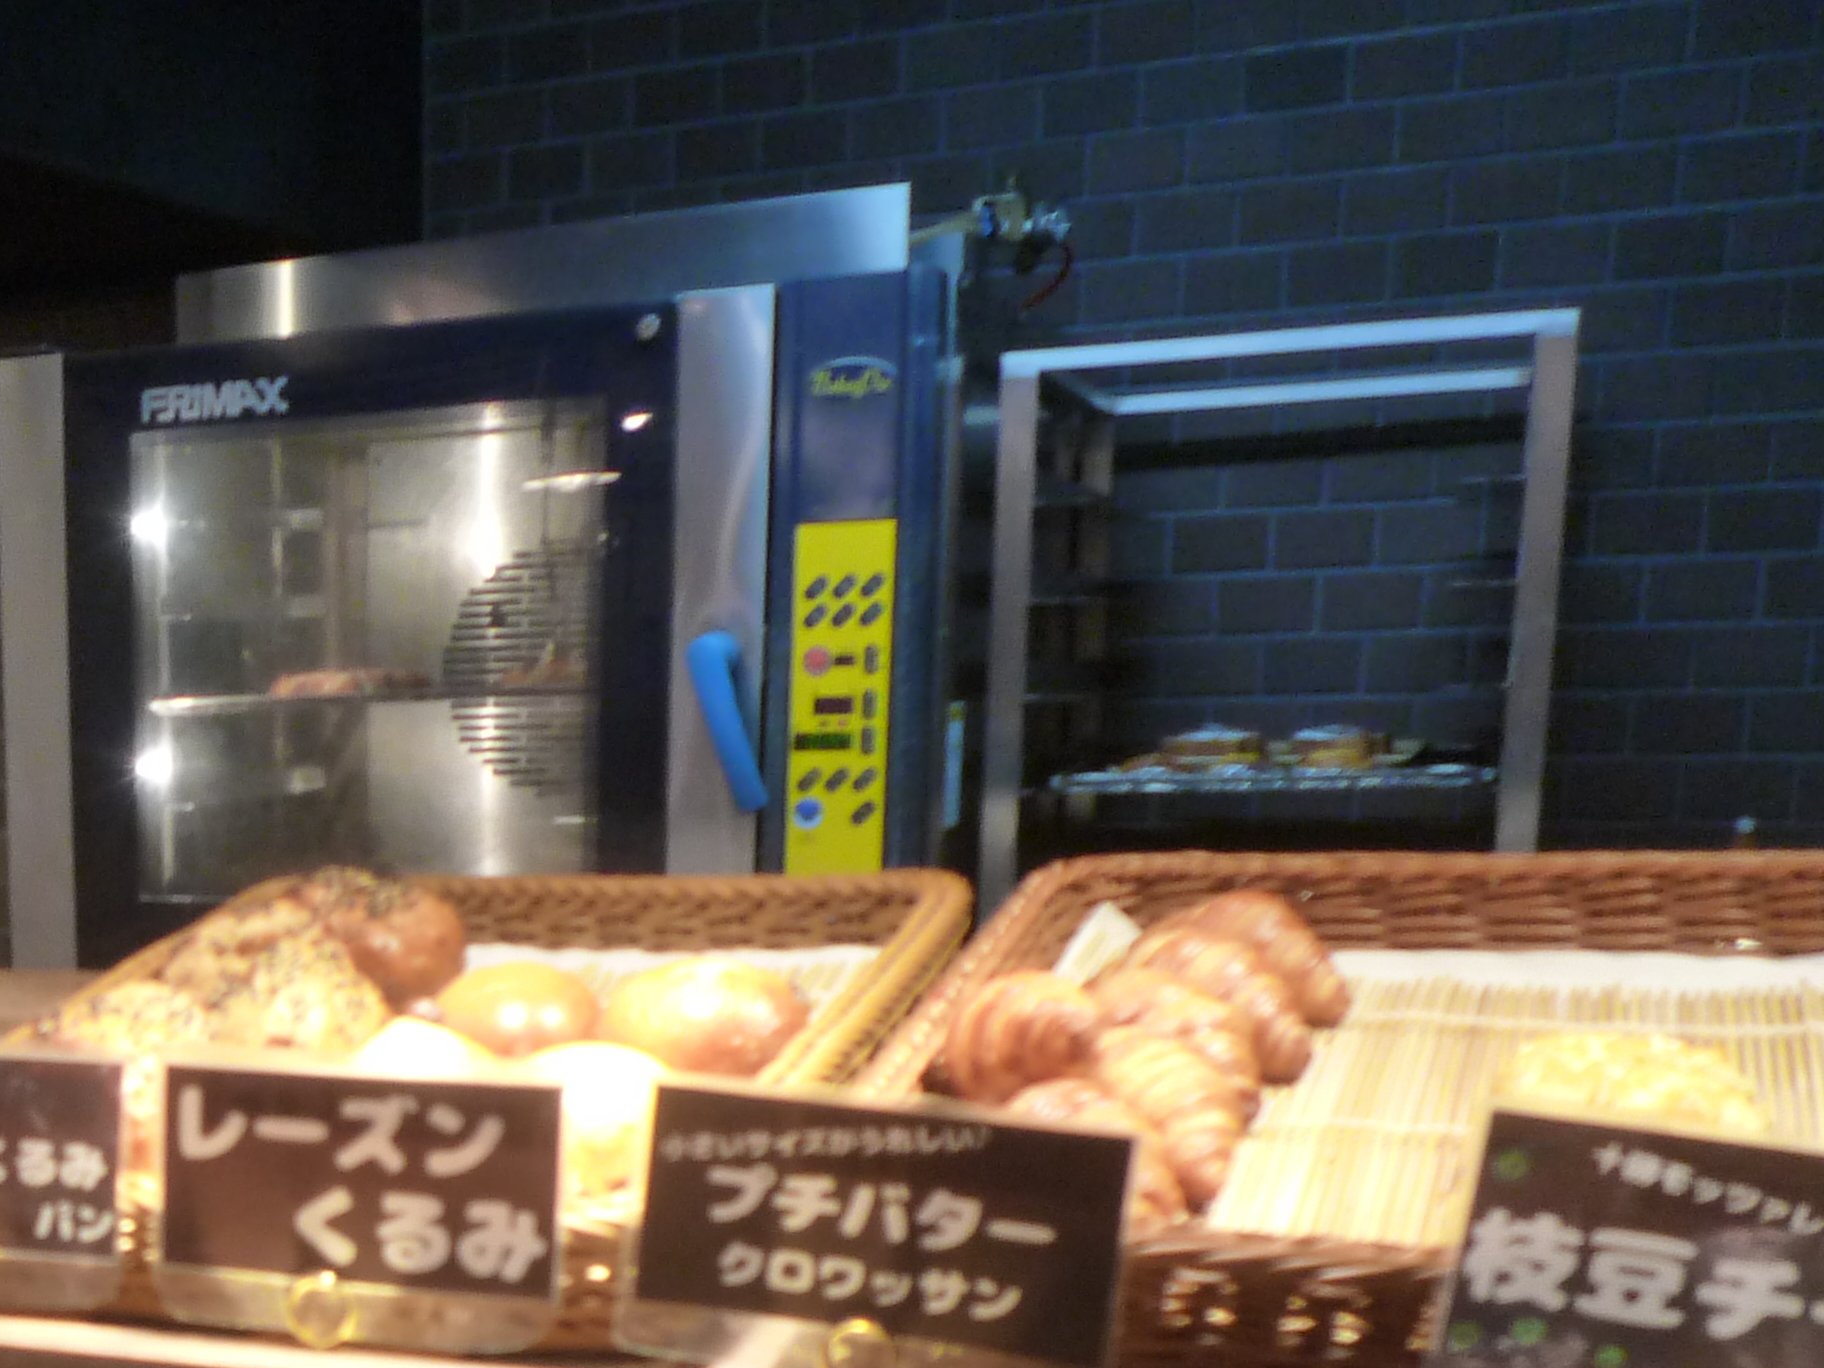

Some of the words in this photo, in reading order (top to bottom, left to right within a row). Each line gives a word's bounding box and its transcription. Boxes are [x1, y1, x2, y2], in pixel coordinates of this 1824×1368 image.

[179, 1084, 505, 1178] レーズン
[34, 1199, 114, 1243] パン
[293, 1185, 547, 1283] くるみ
[705, 1161, 1058, 1251] プチバター
[718, 1240, 1023, 1322] クロワッサン
[1461, 1206, 1824, 1341] 枝豆チ
